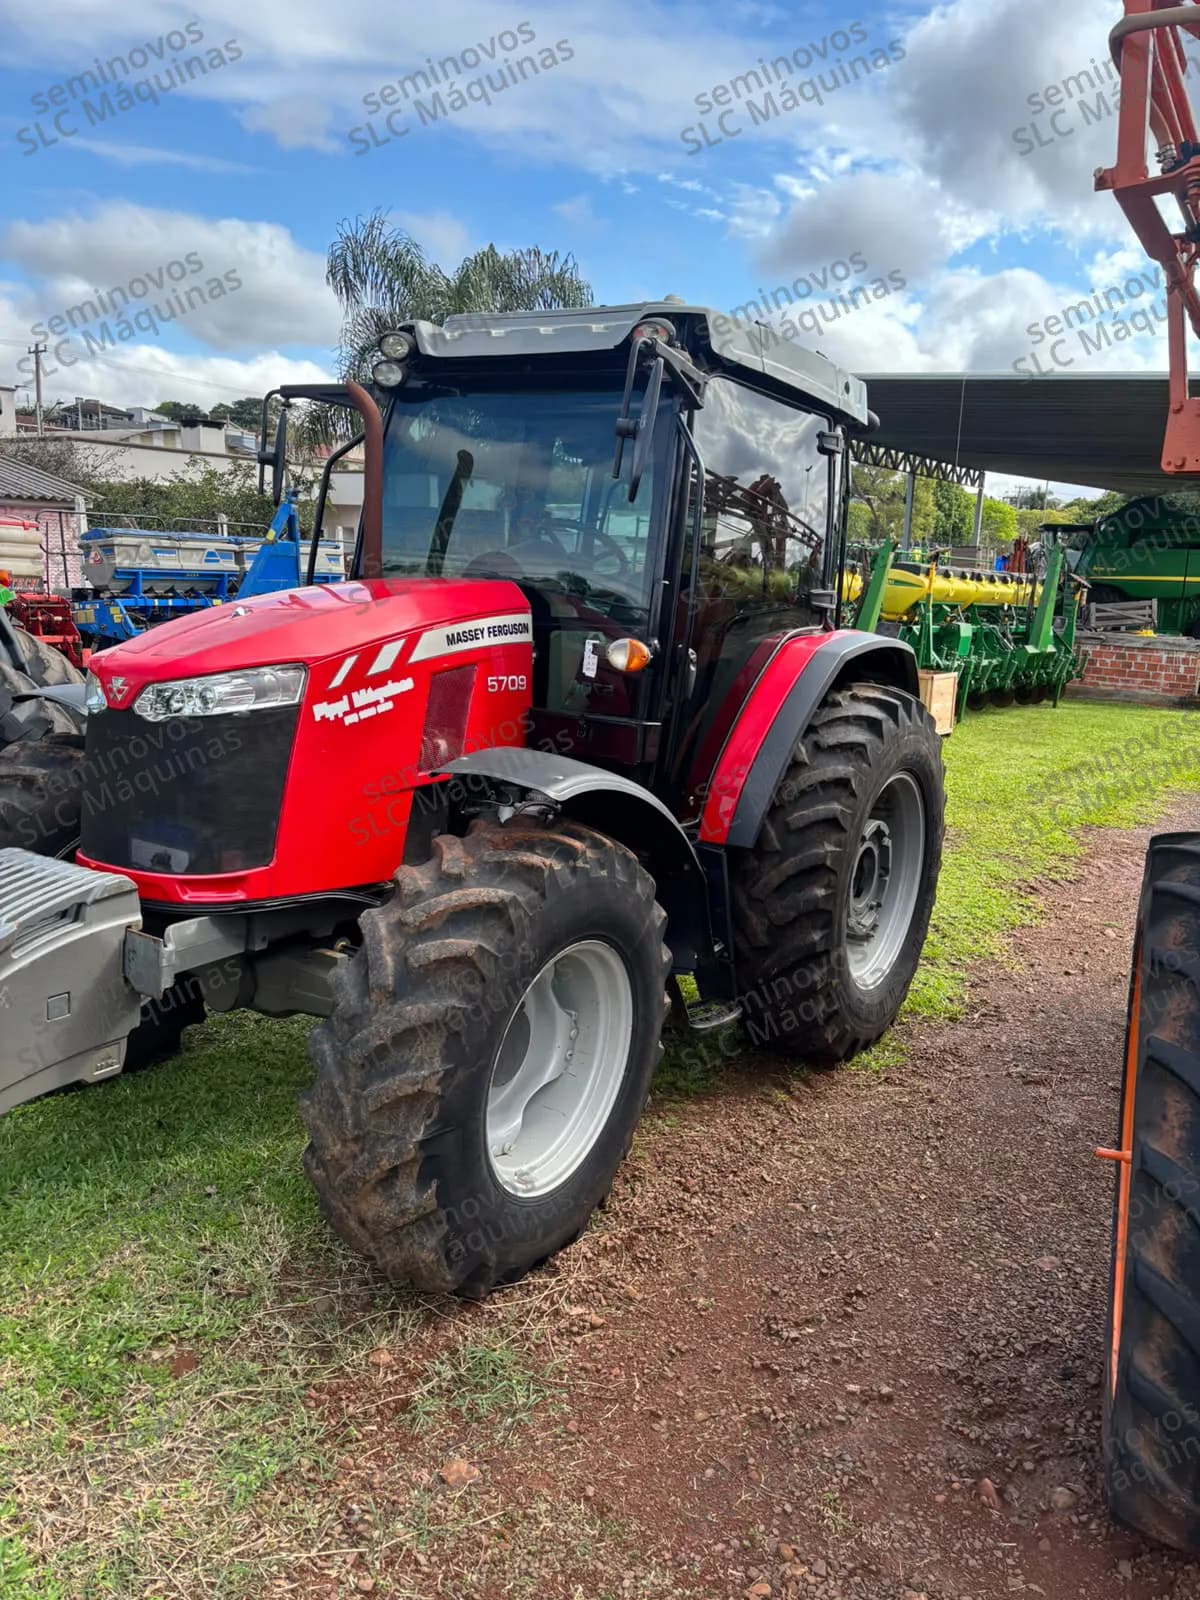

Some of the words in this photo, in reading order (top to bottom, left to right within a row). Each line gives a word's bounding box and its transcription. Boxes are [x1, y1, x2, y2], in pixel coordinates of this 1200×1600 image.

[446, 627, 485, 647] MASSEY
[487, 622, 529, 638] FERGUSON
[487, 675, 527, 693] 5709
